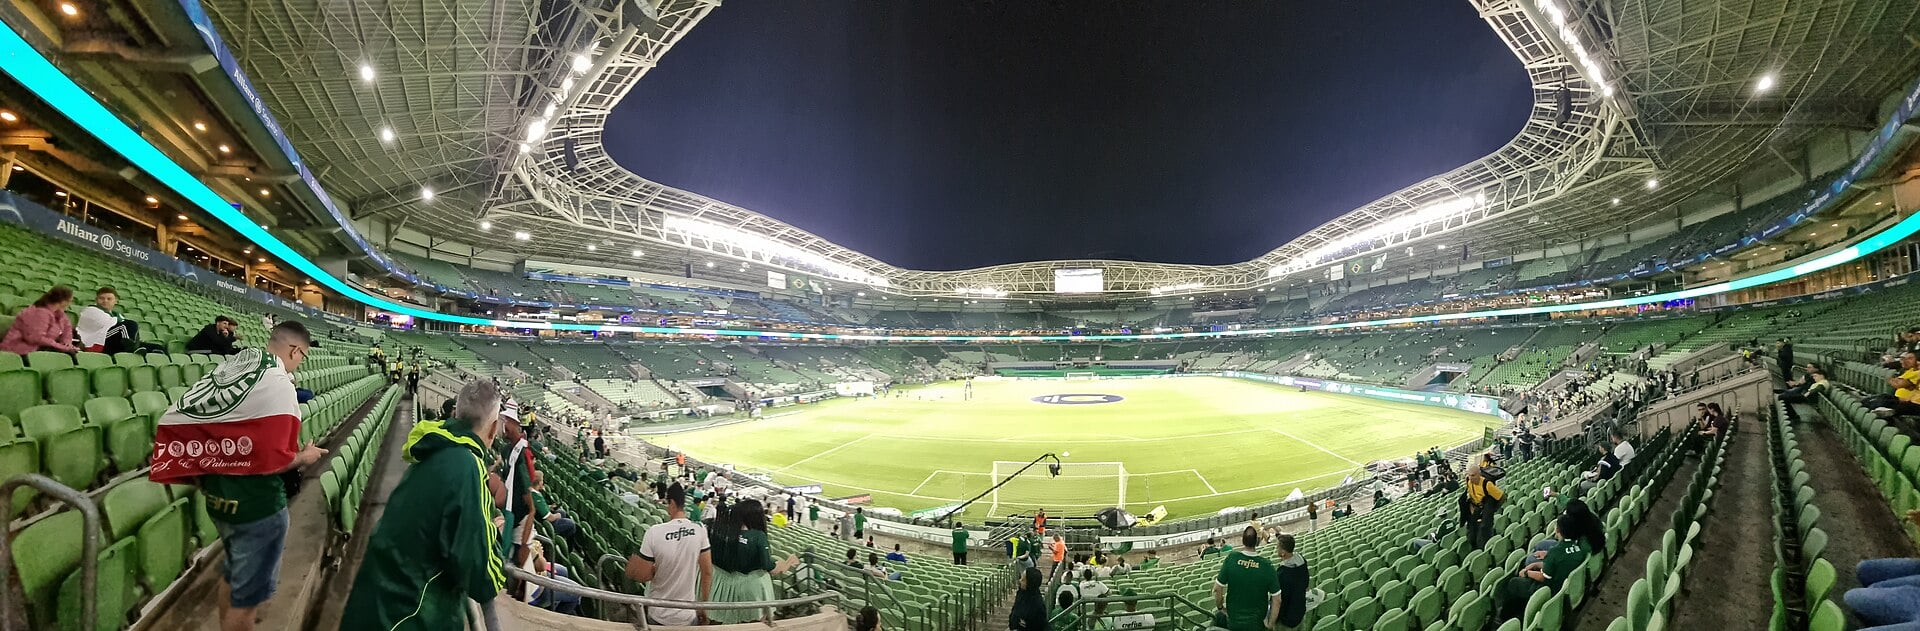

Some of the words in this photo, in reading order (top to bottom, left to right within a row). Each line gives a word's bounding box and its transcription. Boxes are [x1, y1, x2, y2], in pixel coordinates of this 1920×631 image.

[234, 69, 255, 103] Allianz
[56, 219, 99, 243] Allianz
[115, 240, 149, 261] Seguros
[198, 456, 251, 469] Palmeiras
[665, 527, 695, 541] crefisa
